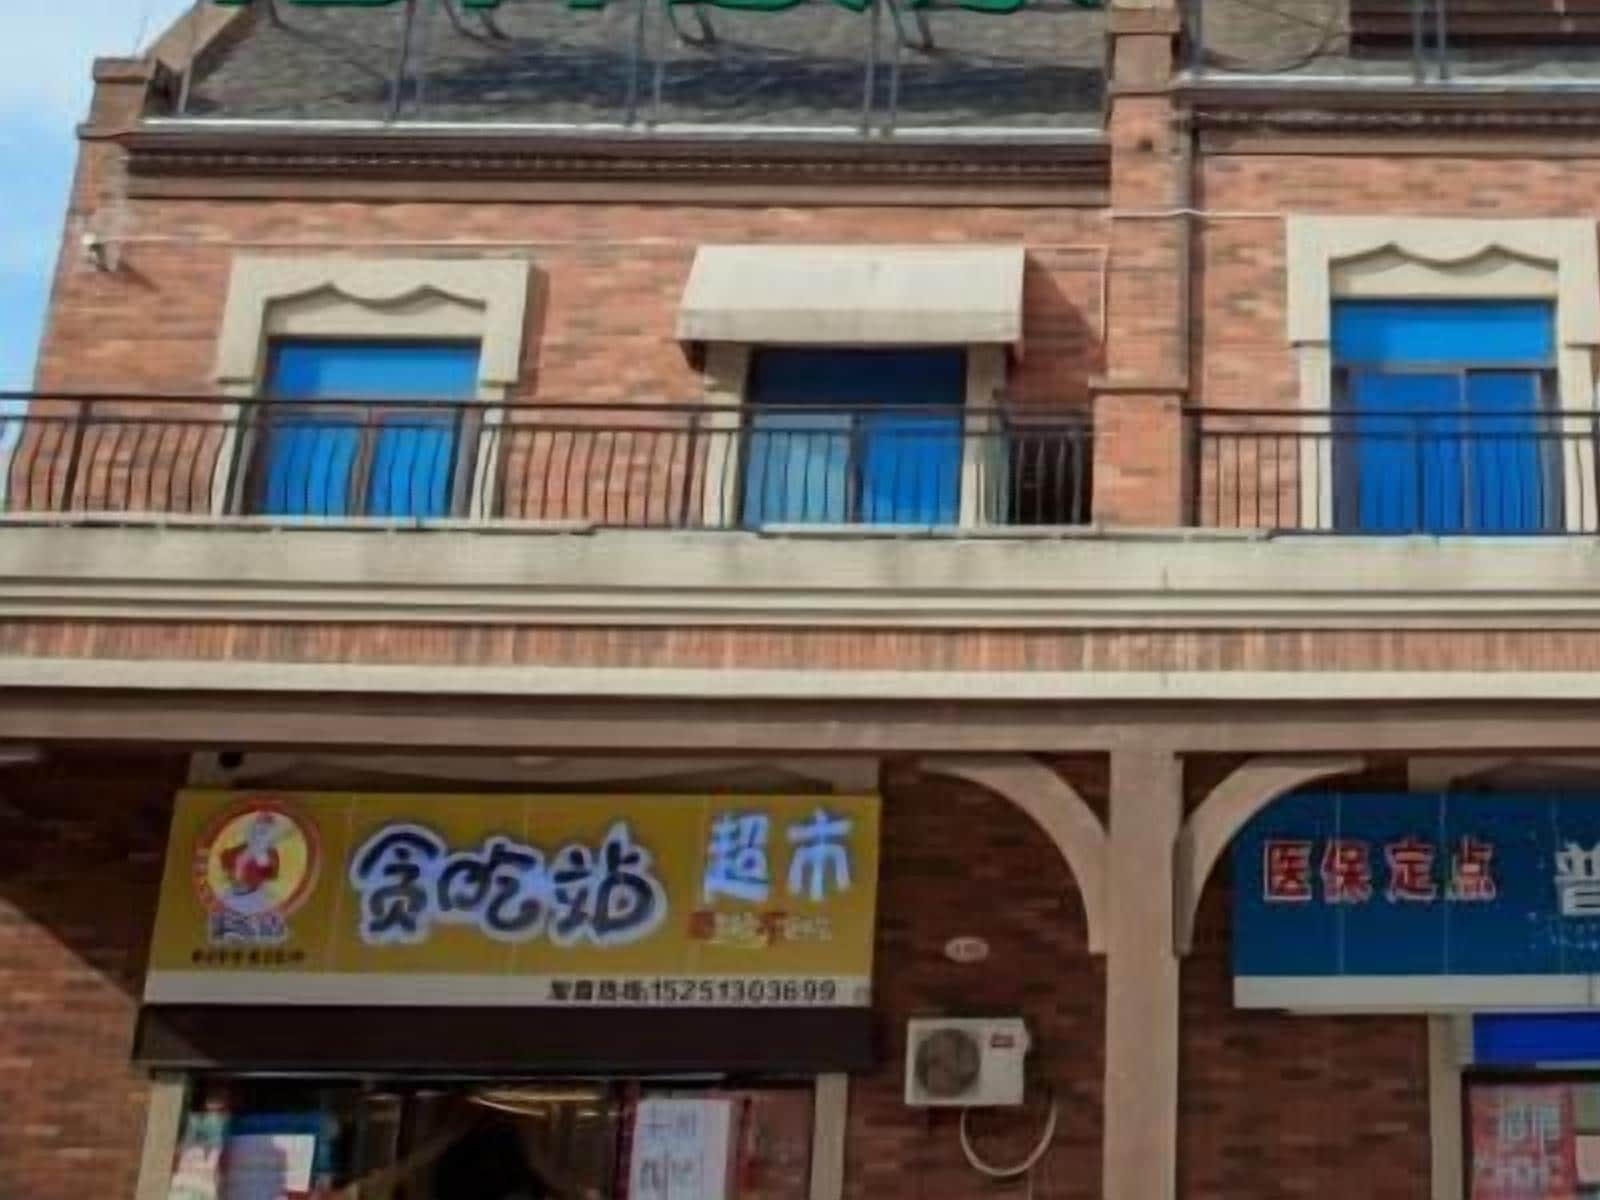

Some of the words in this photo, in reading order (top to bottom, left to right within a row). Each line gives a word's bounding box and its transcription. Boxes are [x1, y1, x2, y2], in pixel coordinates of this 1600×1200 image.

[351, 823, 666, 944] 贪吃站
[704, 810, 853, 902] 超市
[1262, 836, 1496, 903] 医保定点
